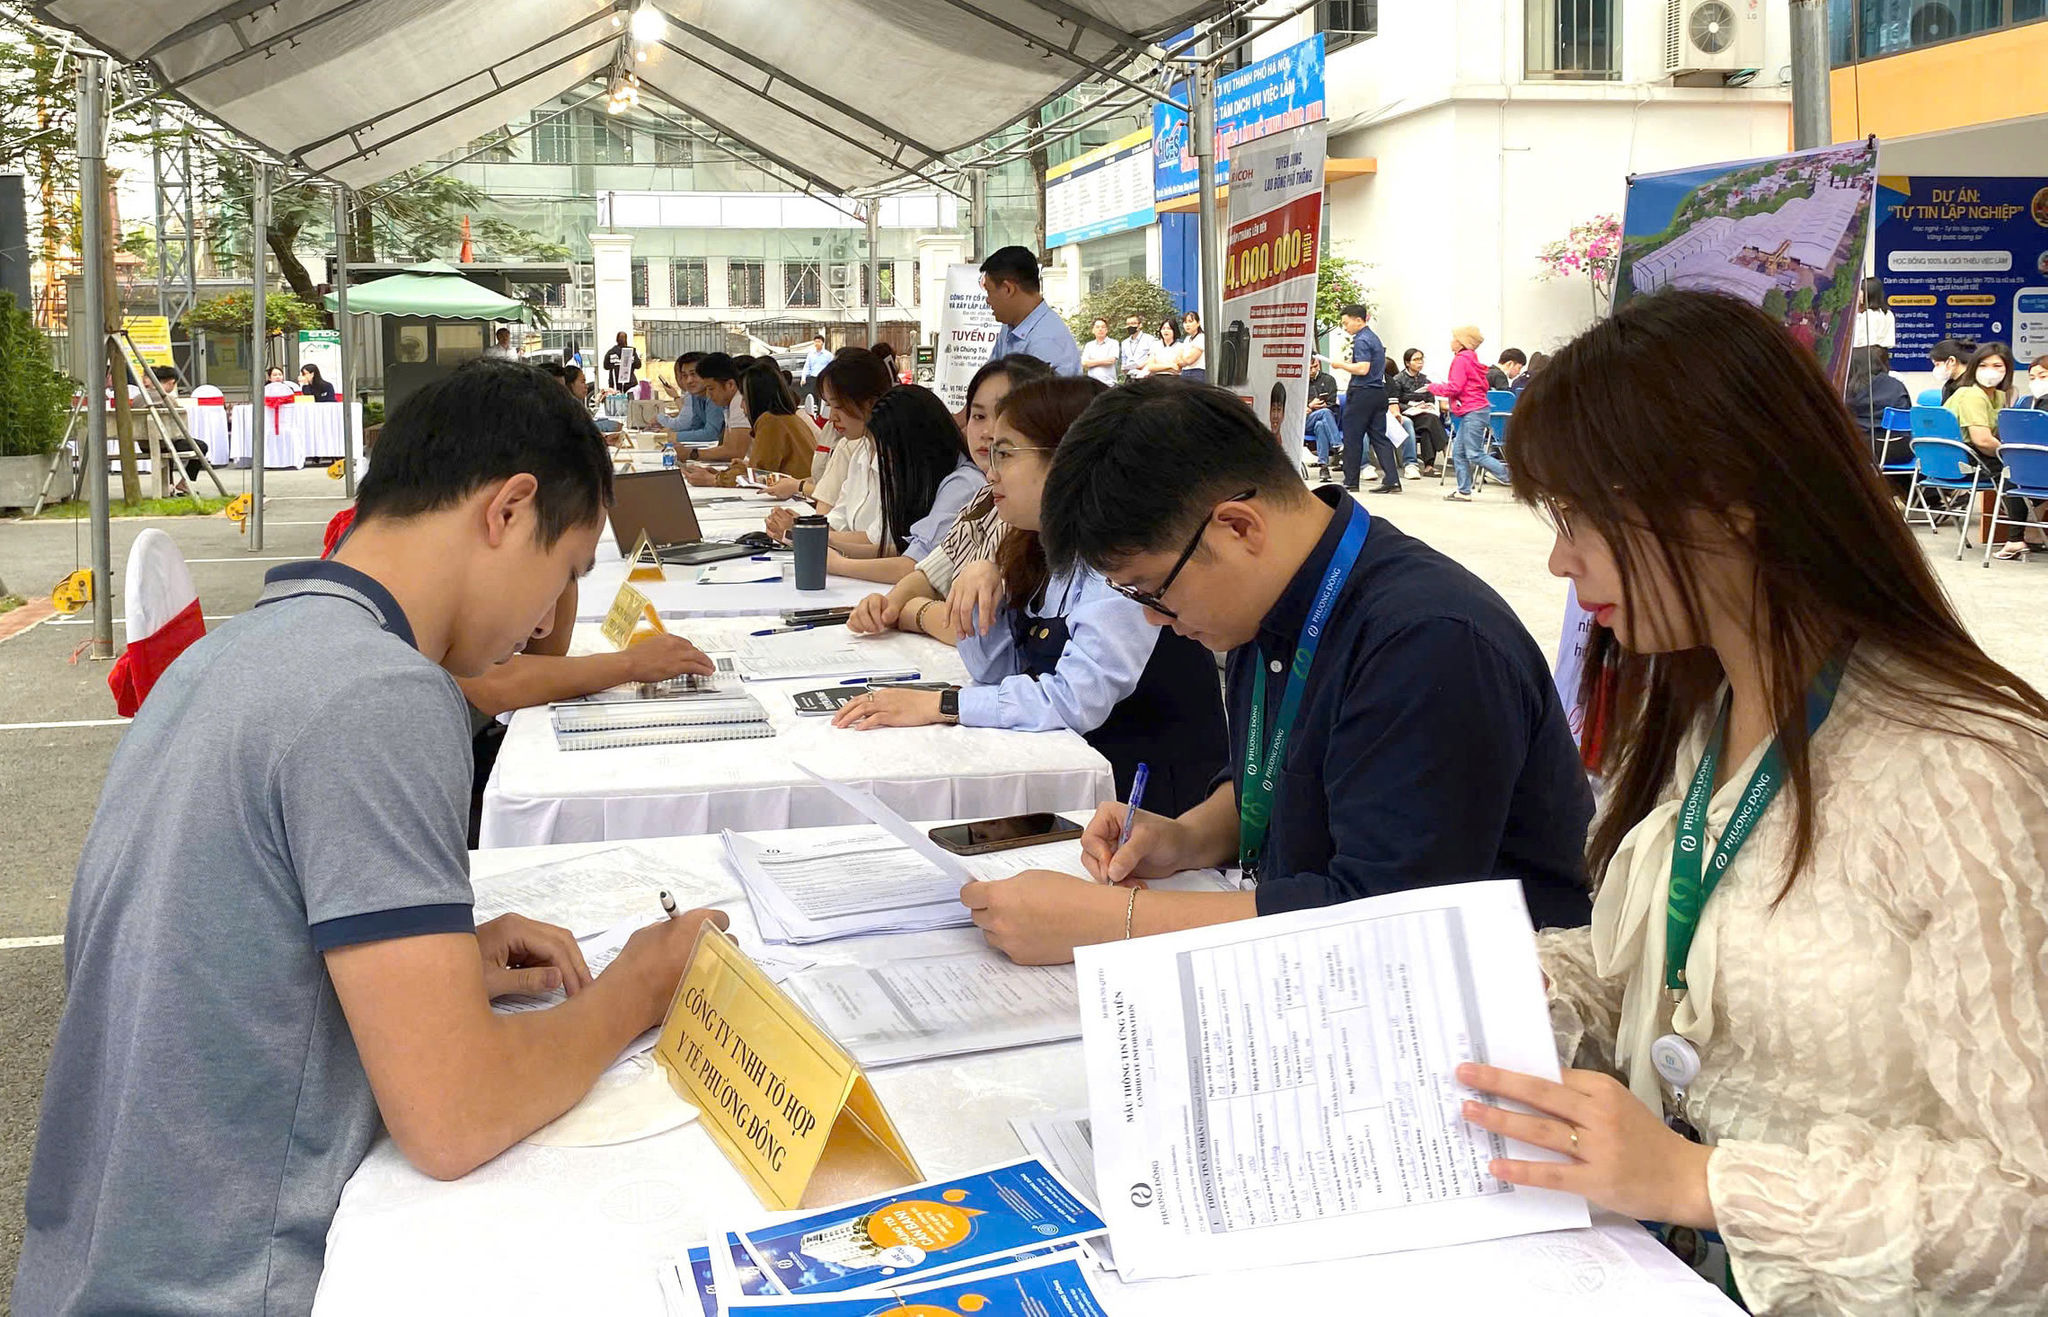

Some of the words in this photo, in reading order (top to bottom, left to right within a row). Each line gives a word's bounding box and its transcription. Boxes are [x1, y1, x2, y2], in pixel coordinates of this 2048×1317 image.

[1253, 60, 1266, 82] PHỐ
[1234, 96, 1250, 117] DỊCH
[1252, 91, 1261, 111] VỤ
[1263, 83, 1278, 106] VIỆC
[1933, 189, 1954, 204] DỰ
[1957, 186, 1980, 202] ÁN:
[1917, 206, 1938, 219] TIN
[1941, 204, 1965, 222] LẬP
[1303, 232, 1312, 263] TRIỆU
[1112, 990, 1124, 1015] VIÊN
[1115, 1018, 1127, 1040] ỨNG
[1127, 1003, 1139, 1060] INFORMATION
[685, 987, 716, 1032] CÔNG
[713, 1015, 738, 1050] TY
[731, 1032, 765, 1089] TNHH
[767, 1069, 788, 1107] TỔ
[784, 1095, 817, 1140] HỢP
[1119, 1042, 1128, 1059] TIN
[1120, 1062, 1133, 1098] THÔNG
[1133, 1062, 1143, 1107] CANDIDATE
[677, 1030, 687, 1054] Y
[685, 1041, 702, 1072] TẾ
[698, 1056, 749, 1131] PHƯƠNG
[746, 1119, 787, 1175] ĐÔNG
[1122, 1100, 1135, 1122] MẪU
[1201, 1162, 1209, 1176] TIN
[1202, 1178, 1216, 1209] THÔNG
